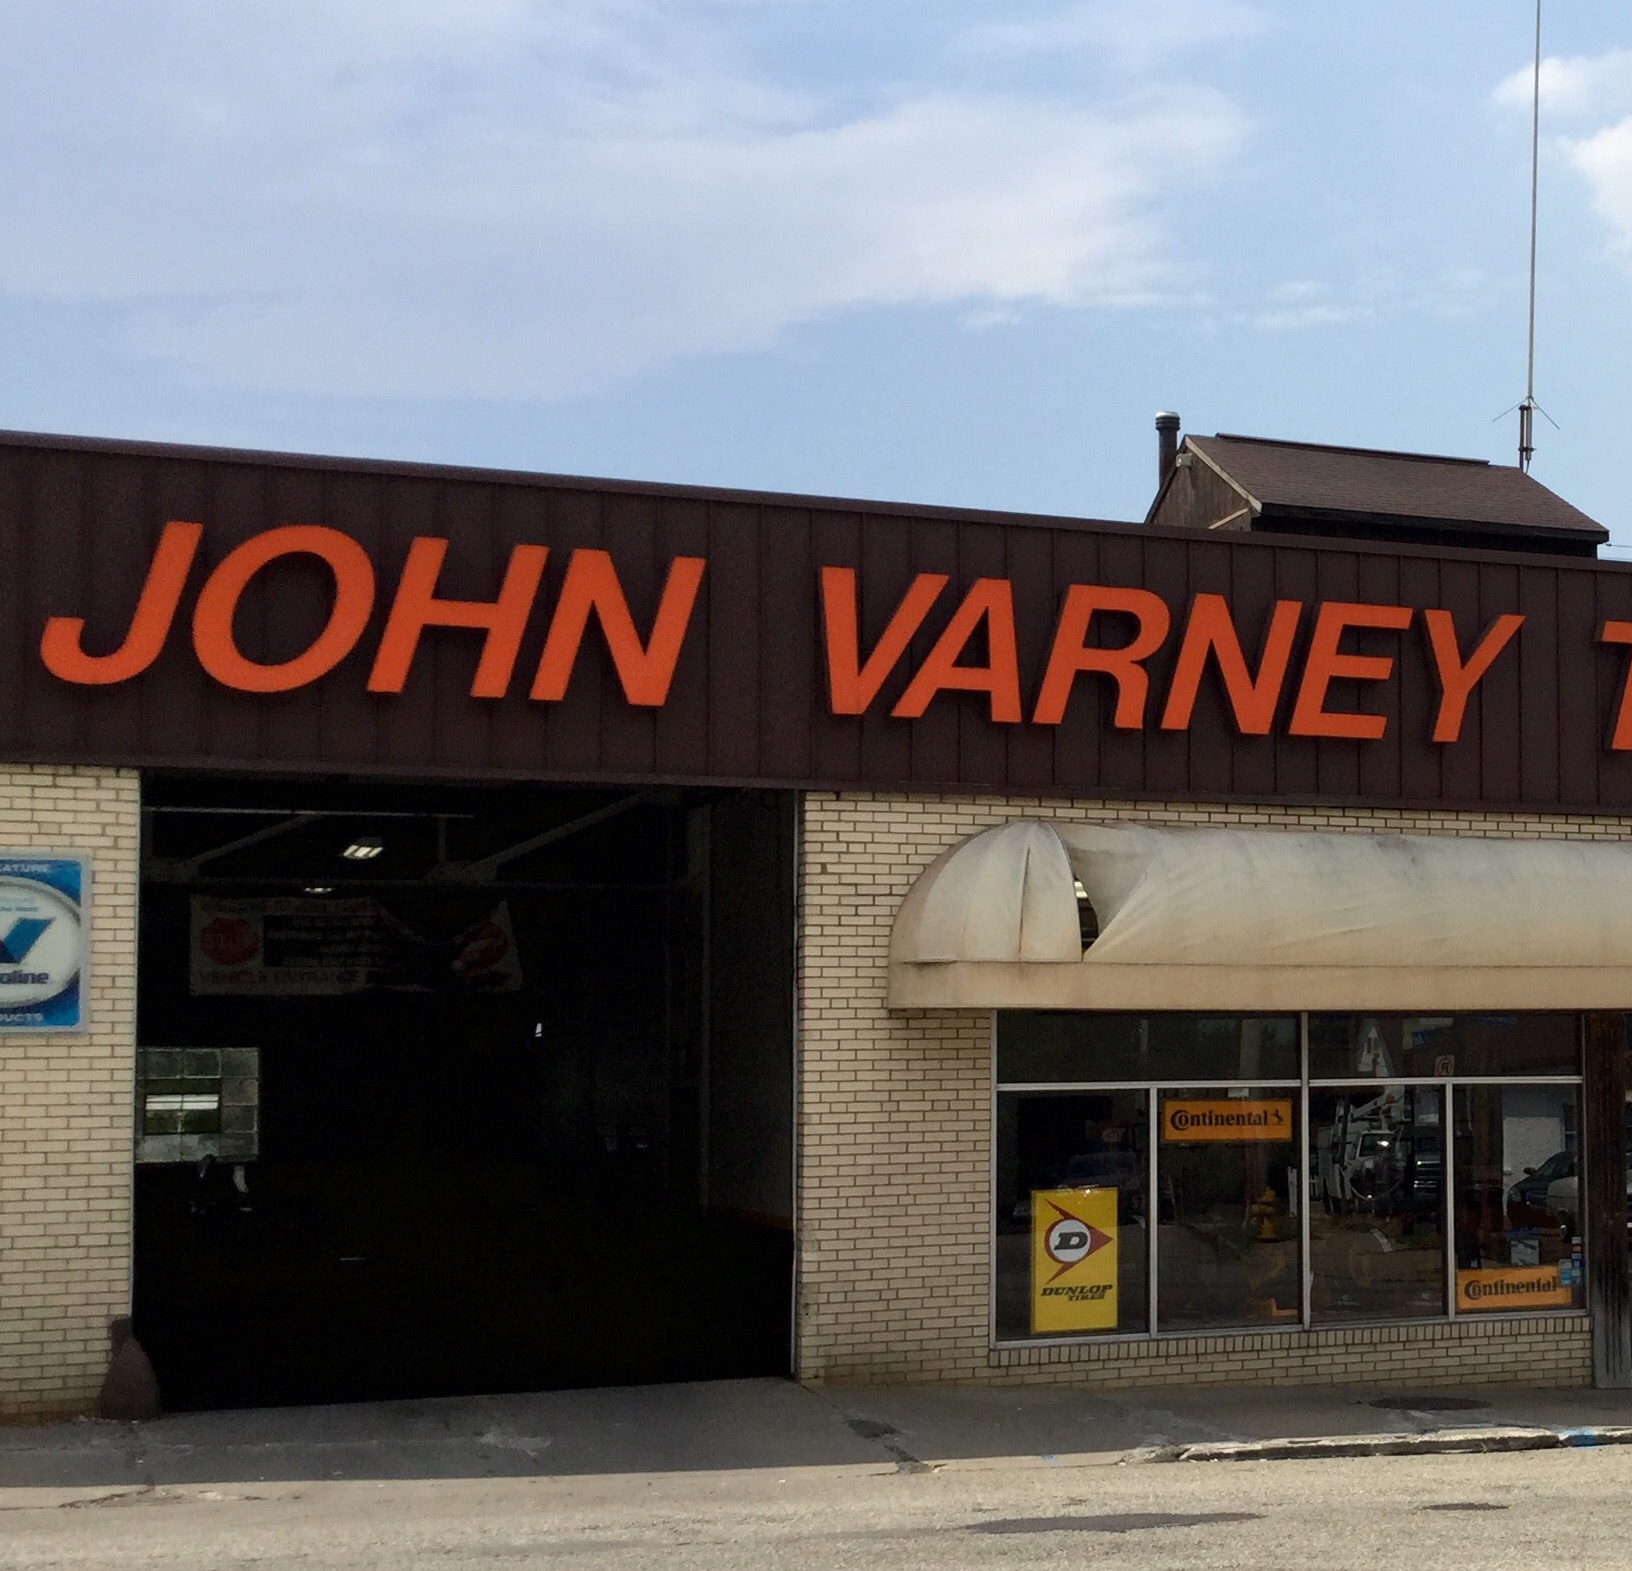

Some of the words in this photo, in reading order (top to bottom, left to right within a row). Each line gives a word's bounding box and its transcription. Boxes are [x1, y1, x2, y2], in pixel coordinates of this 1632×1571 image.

[40, 521, 705, 706] JOHN
[822, 566, 1525, 742] VARNEY
[1170, 1109, 1268, 1131] Continental
[1053, 1231, 1089, 1250] D
[1040, 1284, 1113, 1297] DUNLOP
[1464, 1276, 1557, 1300] Continental
